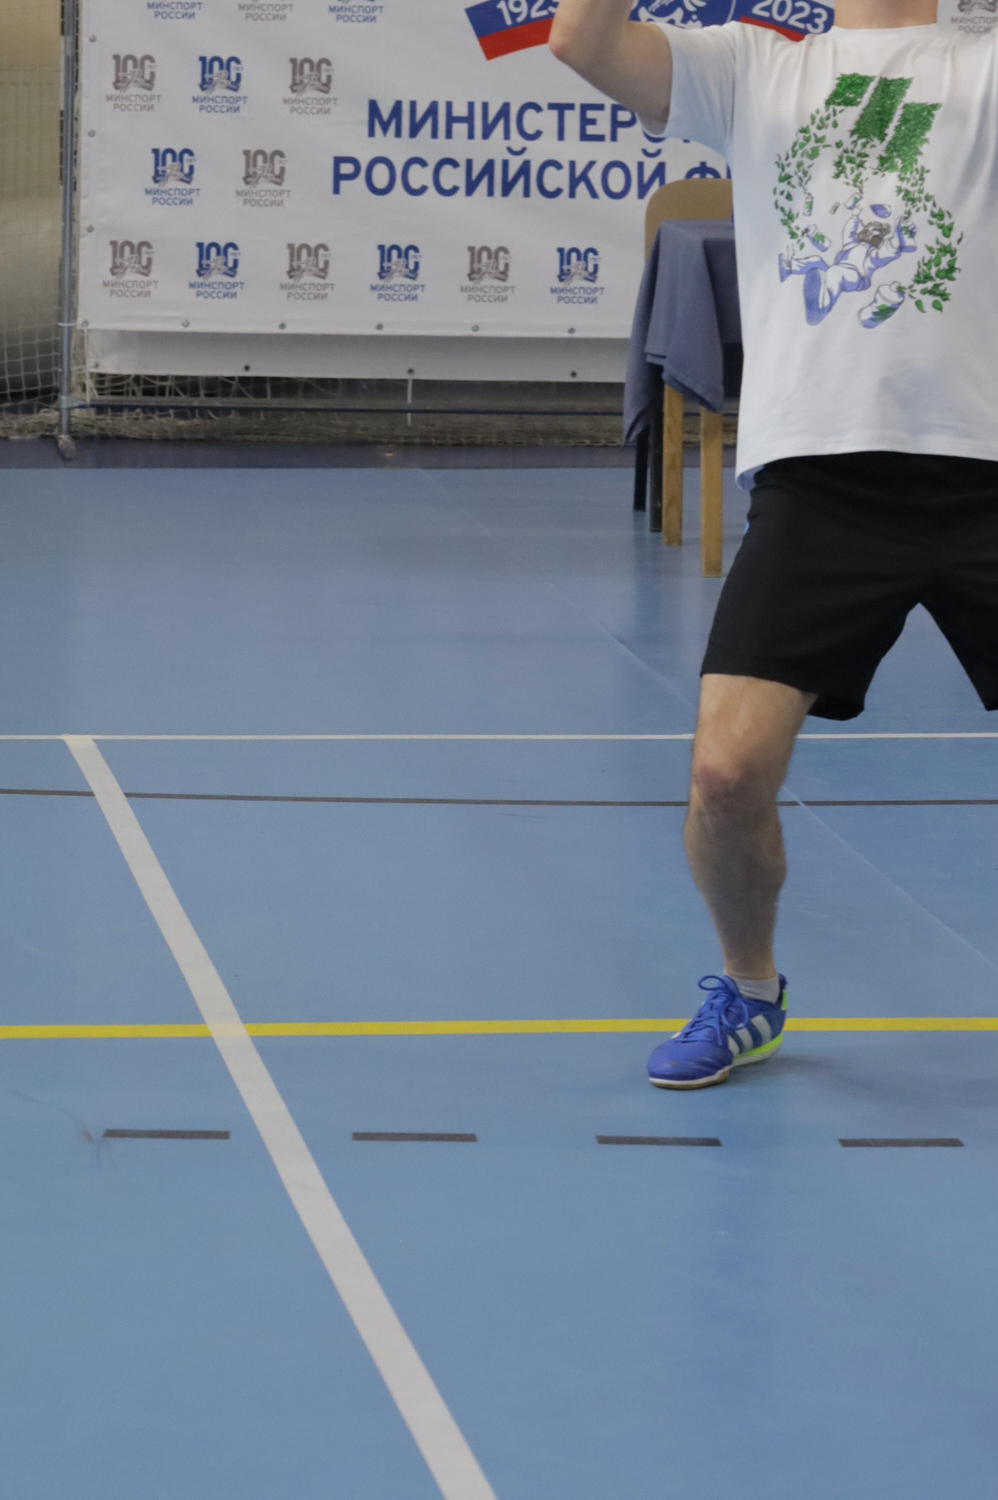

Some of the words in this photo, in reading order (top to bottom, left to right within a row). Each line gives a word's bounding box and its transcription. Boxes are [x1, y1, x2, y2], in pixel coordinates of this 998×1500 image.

[147, 1, 203, 11] МИНСПОРТ
[238, 3, 294, 13] МИНСПОРТ
[329, 5, 384, 14] МИНСПОРТ
[154, 11, 196, 20] РОССИИ
[245, 13, 287, 22] РОССИИ
[336, 14, 377, 24] РОССИИ
[106, 94, 162, 103] МИНСПОРТ
[192, 95, 247, 105] МИНСПОРТ
[283, 97, 338, 106] МИНСПОРТ
[113, 103, 155, 113] РОССИИ
[199, 105, 240, 114] РОССИИ
[290, 106, 331, 116] РОССИИ
[367, 99, 666, 143] МИНИСТЕР
[332, 146, 667, 200] РОССИЙСКОЙ
[145, 187, 201, 197] МИНСПОРТ
[236, 189, 292, 198] МИНСПОРТ
[152, 197, 194, 207] РОССИИ
[243, 199, 285, 208] РОССИИ
[103, 280, 159, 289] МИНСПОРТ
[189, 281, 245, 290] МИНСПОРТ
[280, 283, 335, 292] МИНСПОРТ
[370, 284, 426, 293] МИНСПОРТ
[110, 289, 152, 299] РОССИИ
[460, 285, 516, 294] МИНСПОРТ
[550, 286, 605, 295] МИНСПОРТ
[196, 291, 238, 300] РОССИИ
[287, 292, 328, 301] РОССИИ
[378, 293, 419, 302] РОССИИ
[468, 295, 509, 304] РОССИИ
[557, 296, 598, 305] РОССИИ
